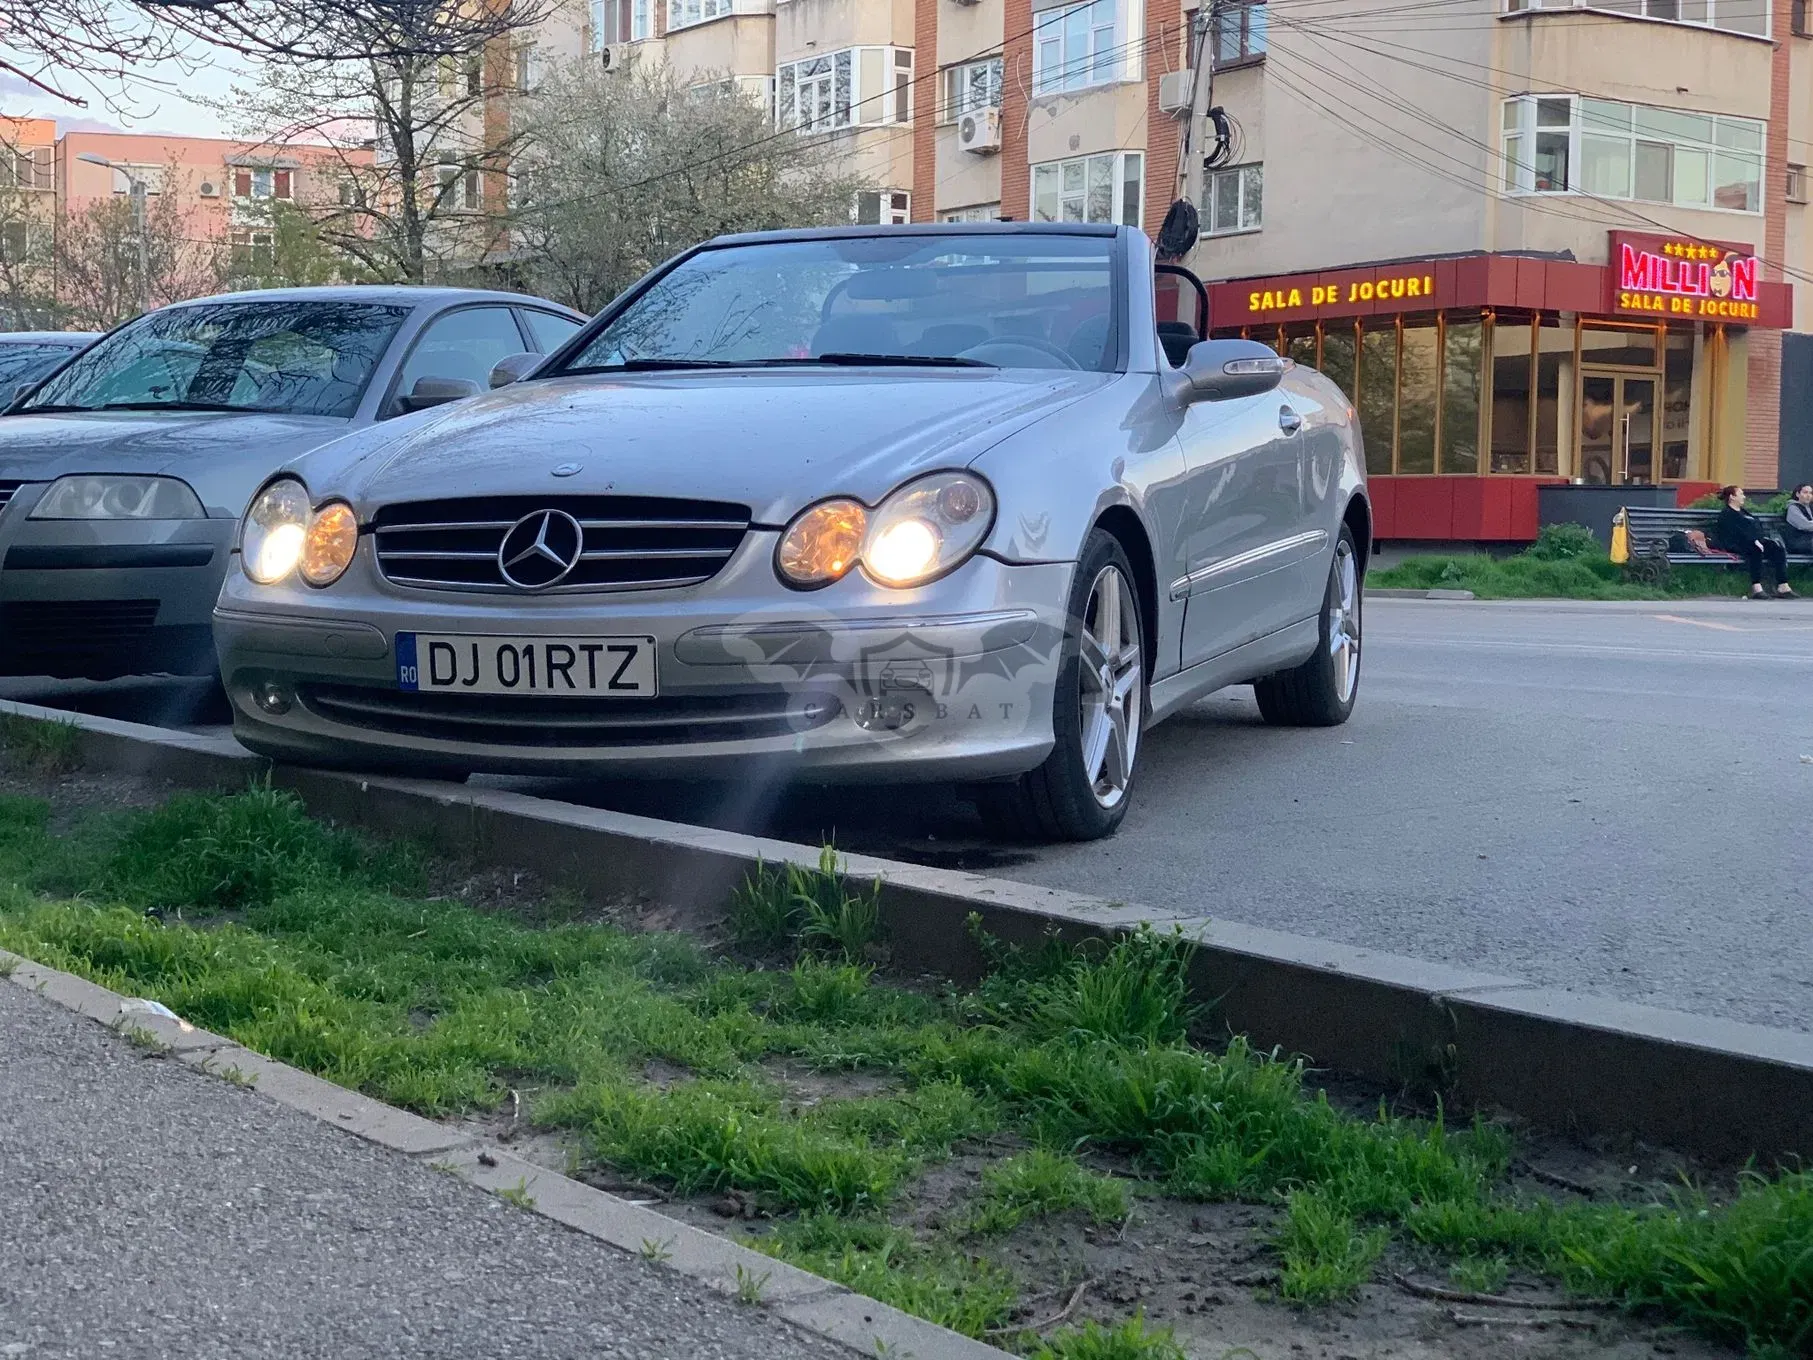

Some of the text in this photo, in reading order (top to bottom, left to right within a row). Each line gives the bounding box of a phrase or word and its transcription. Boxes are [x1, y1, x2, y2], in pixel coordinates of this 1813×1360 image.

[1249, 276, 1432, 311] SALA DE JOCURI
[1620, 292, 1758, 318] SALA DE JOCURI
[401, 665, 418, 684] RO
[429, 642, 480, 687] DJ
